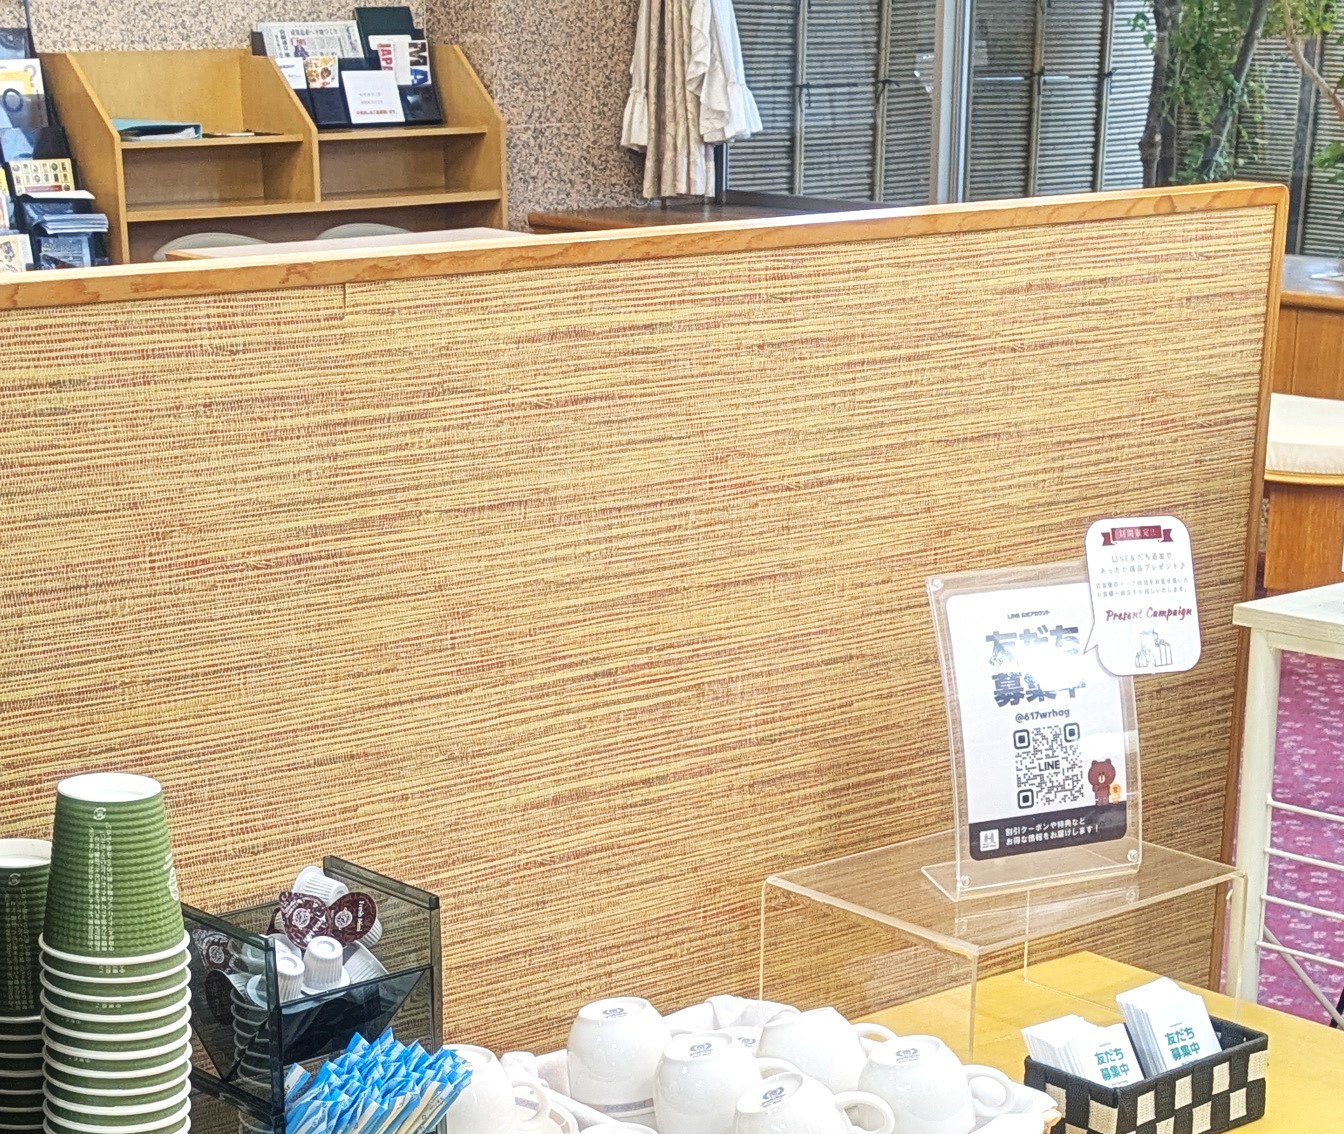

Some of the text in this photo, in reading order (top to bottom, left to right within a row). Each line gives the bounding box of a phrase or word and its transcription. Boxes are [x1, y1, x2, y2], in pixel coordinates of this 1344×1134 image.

[1105, 606, 1193, 622] Present Campaign
[992, 671, 1087, 708] 募集
[1038, 760, 1060, 772] LINE
[1005, 816, 1086, 837] 割引クーポンや特典など
[1165, 1026, 1195, 1047] 友だち
[1094, 1047, 1125, 1066] 友だち
[1170, 1041, 1201, 1062] 募集中
[1099, 1062, 1130, 1082] 募集中
